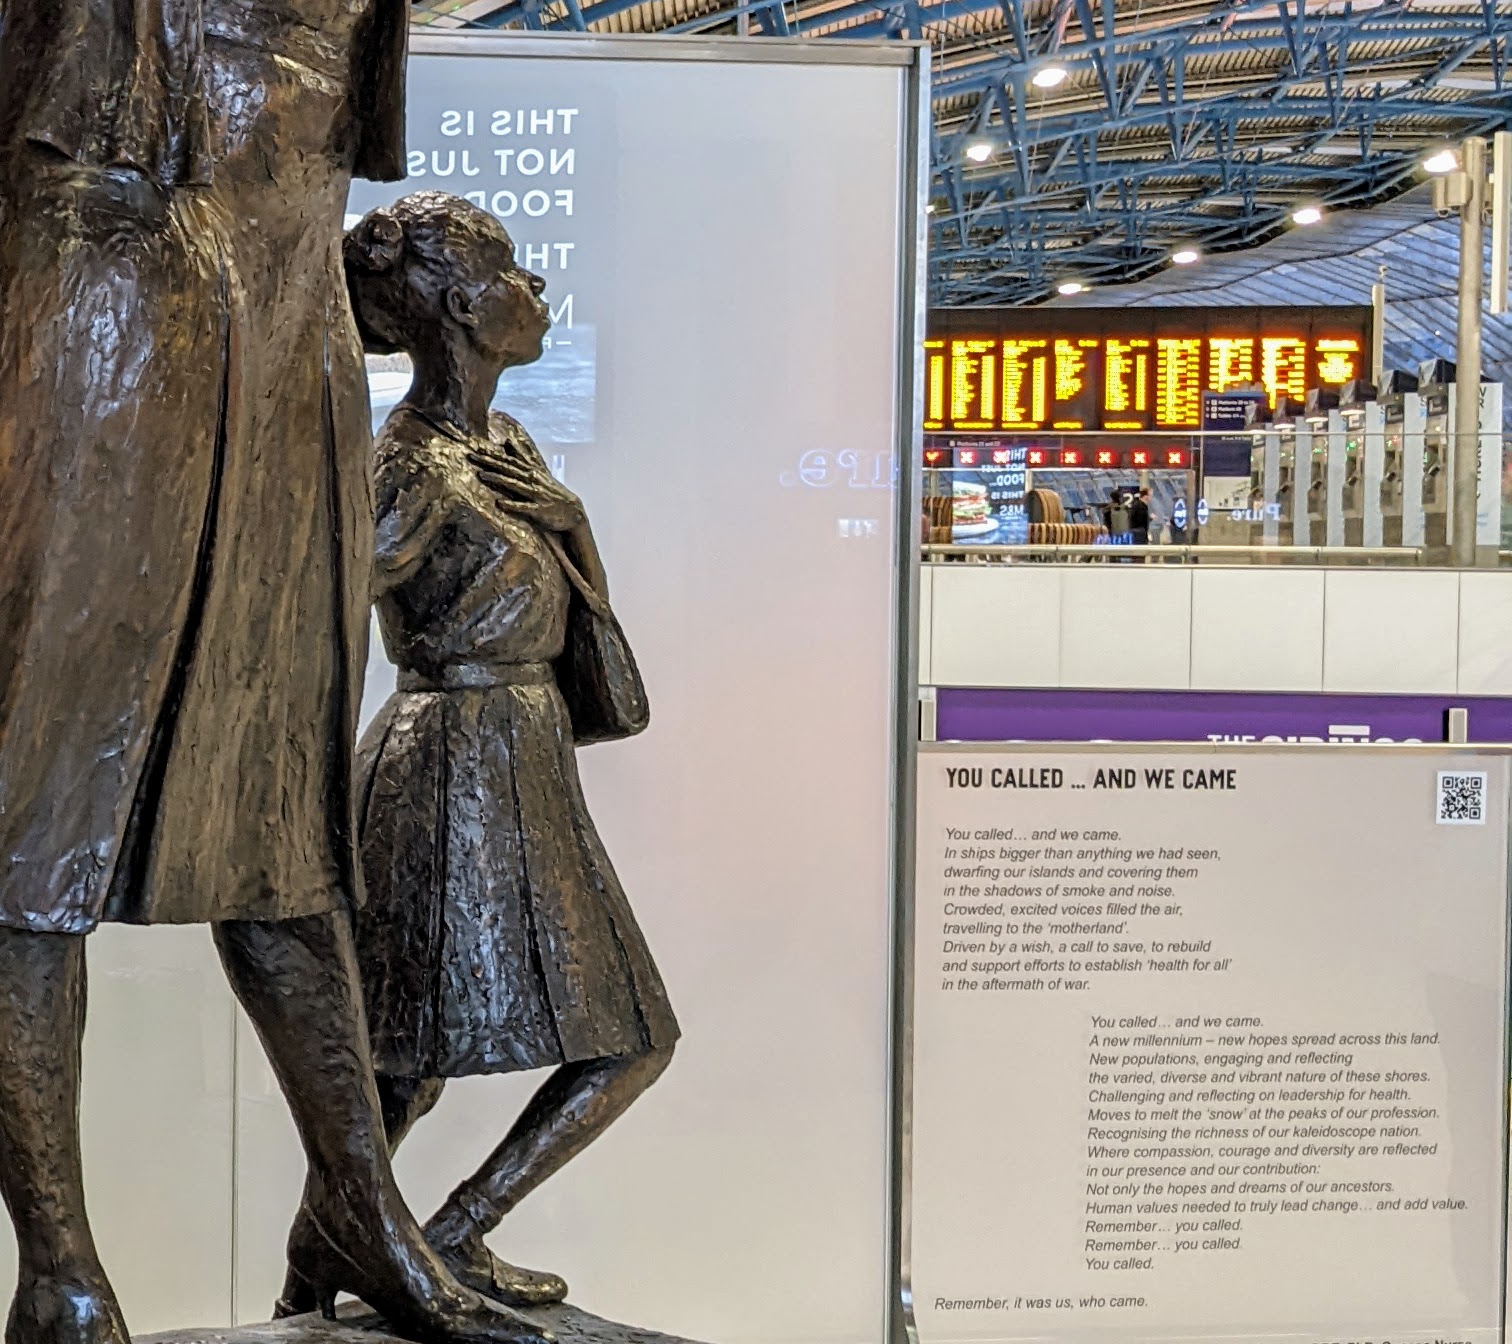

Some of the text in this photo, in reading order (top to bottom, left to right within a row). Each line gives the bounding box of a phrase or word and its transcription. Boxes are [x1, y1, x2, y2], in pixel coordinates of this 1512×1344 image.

[945, 767, 983, 788] YOU
[990, 767, 1063, 789] CALLED
[1092, 768, 1136, 789] AND
[1143, 768, 1175, 789] WE
[1182, 768, 1236, 790] CAME
[944, 846, 1221, 863] In ships bigger than anything we had seen,
[943, 864, 1199, 881] dwarfing our islands and covering them
[942, 939, 1212, 956] Driven by a wish, a call to save, to rebuild
[1088, 1051, 1354, 1068] New populations, engaging and reflecting
[1088, 1069, 1430, 1085] the varied, diverse and vibrant nature of these shores.
[1087, 1124, 1421, 1143] Recognising the richness of our kaleidoscope nation.
[1087, 1142, 1438, 1160] Where compassion, courage and diversity are reflected
[1085, 1256, 1154, 1270] You called.
[934, 1294, 1148, 1310] Remember, it was us, who came.
